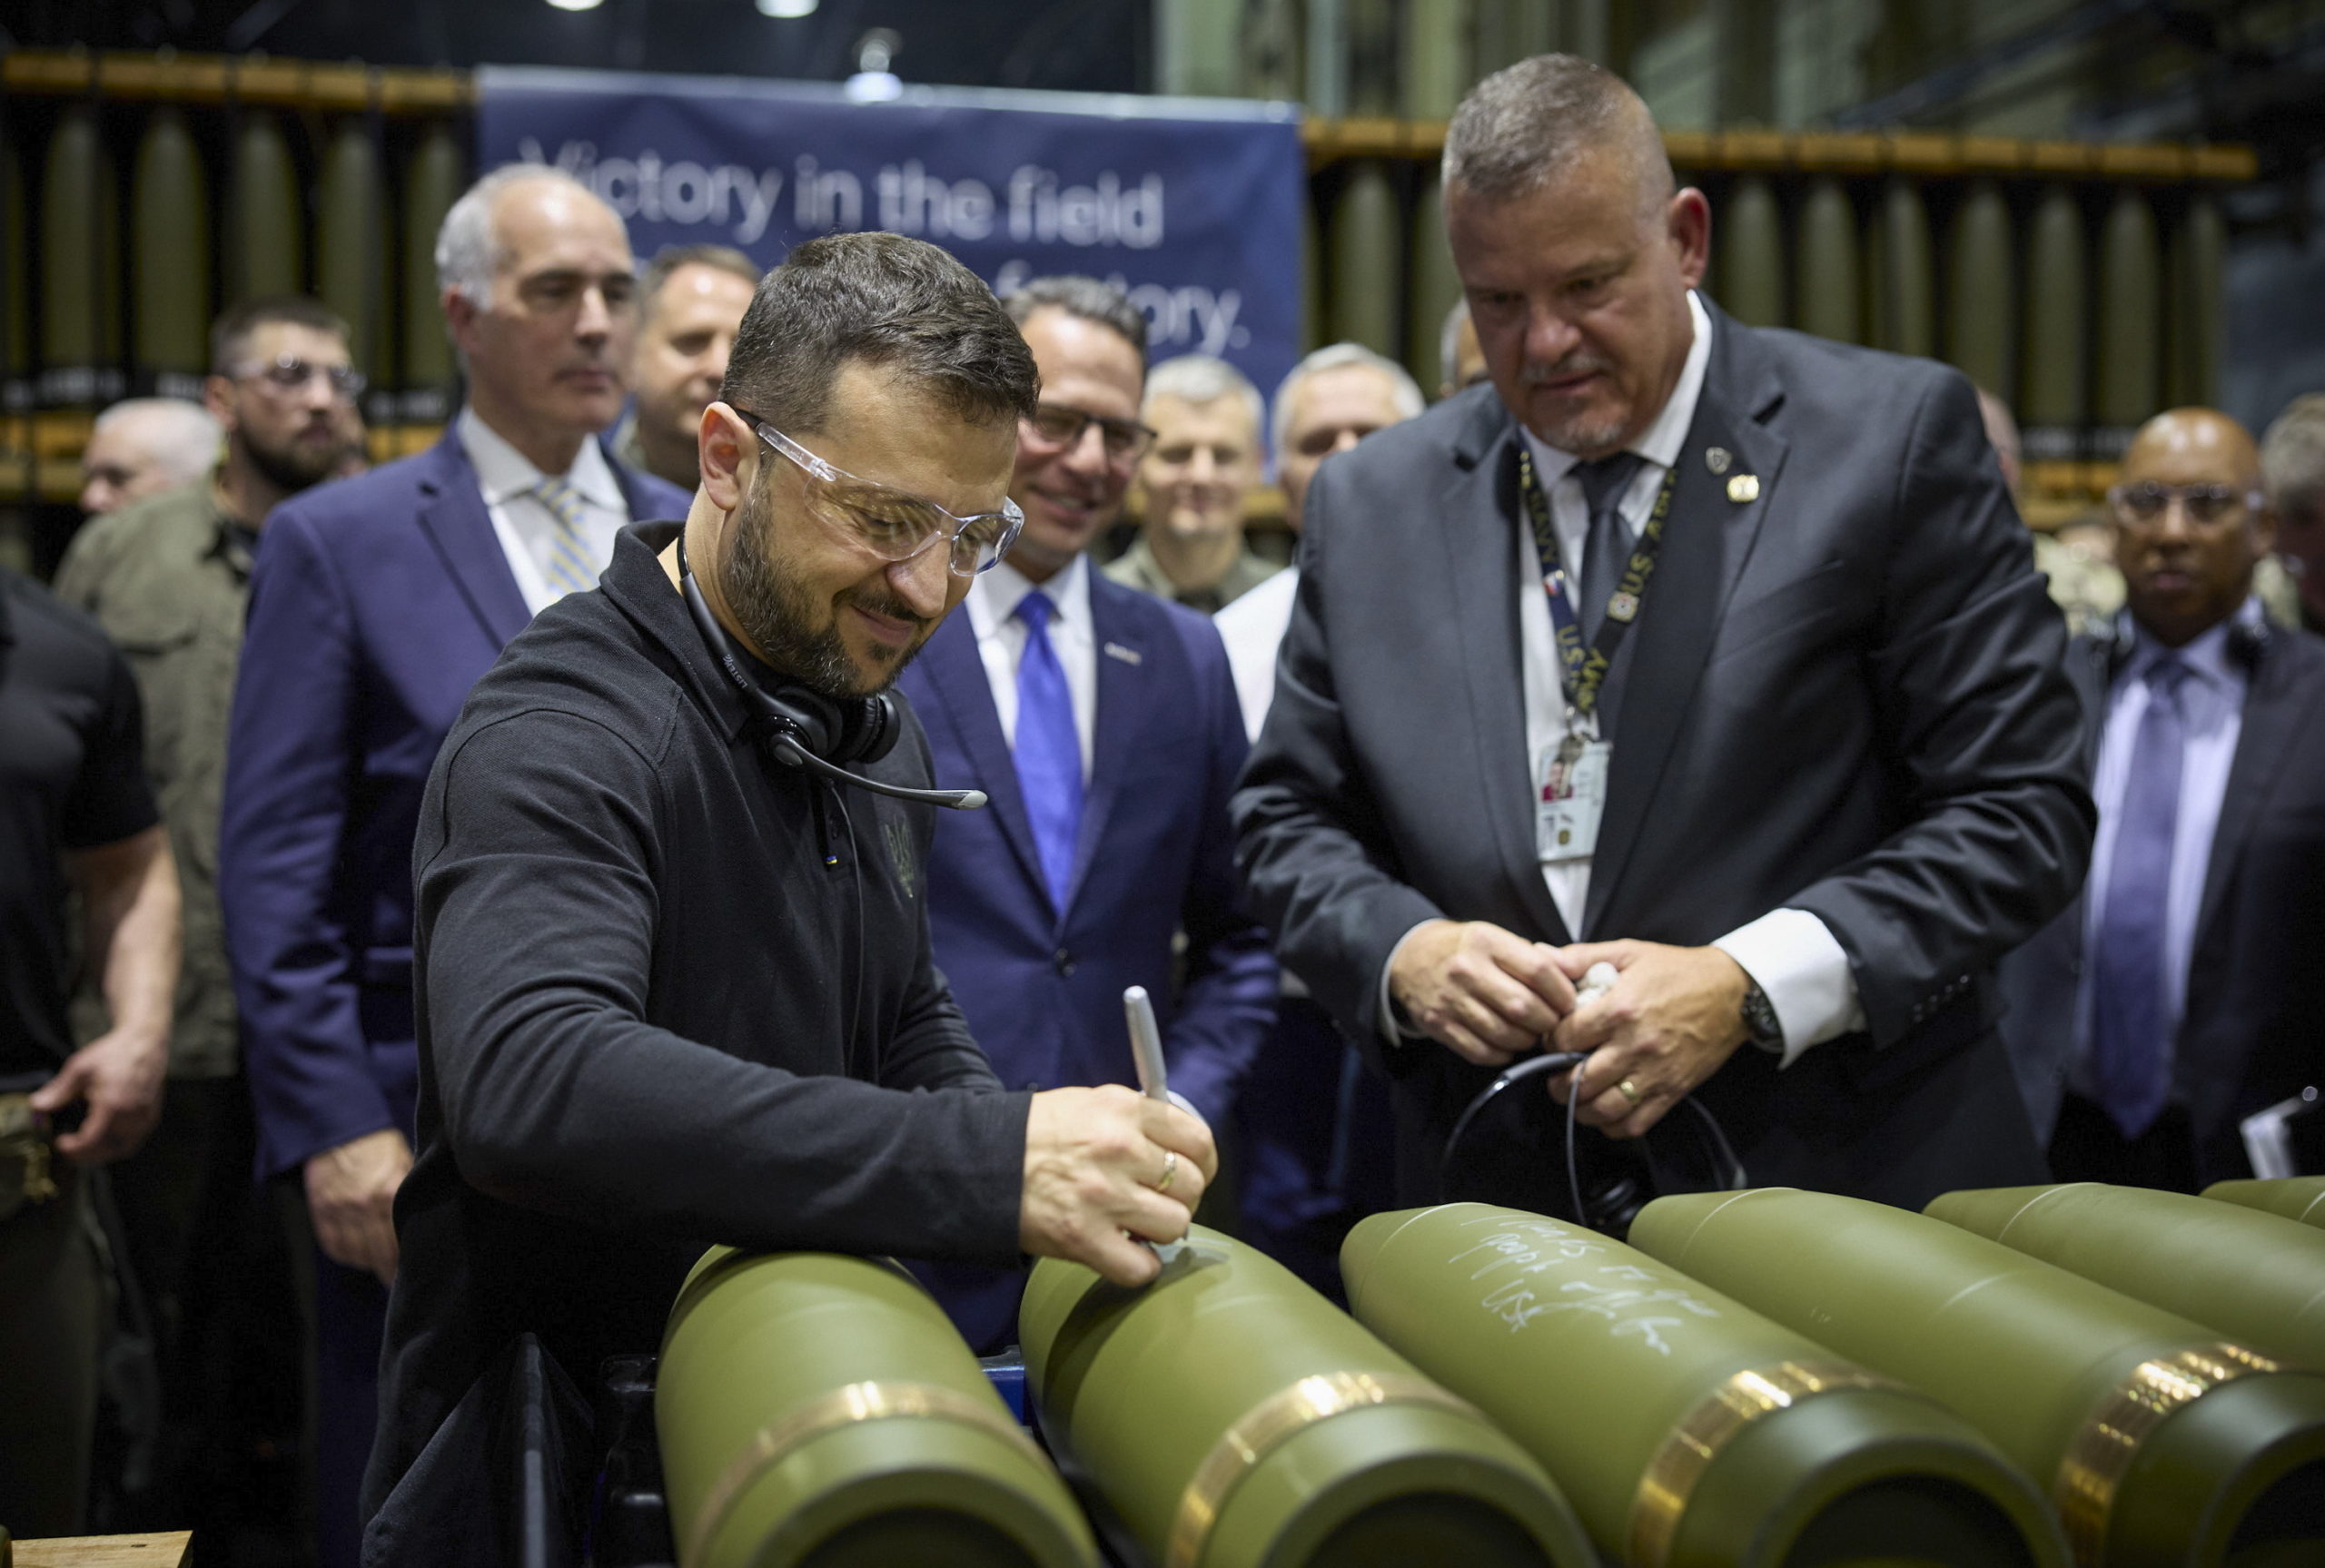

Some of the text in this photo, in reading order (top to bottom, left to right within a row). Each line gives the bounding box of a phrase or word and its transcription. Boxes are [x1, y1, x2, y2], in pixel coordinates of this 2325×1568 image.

[795, 153, 863, 232] in
[879, 158, 995, 241] the
[1008, 164, 1164, 249] field
